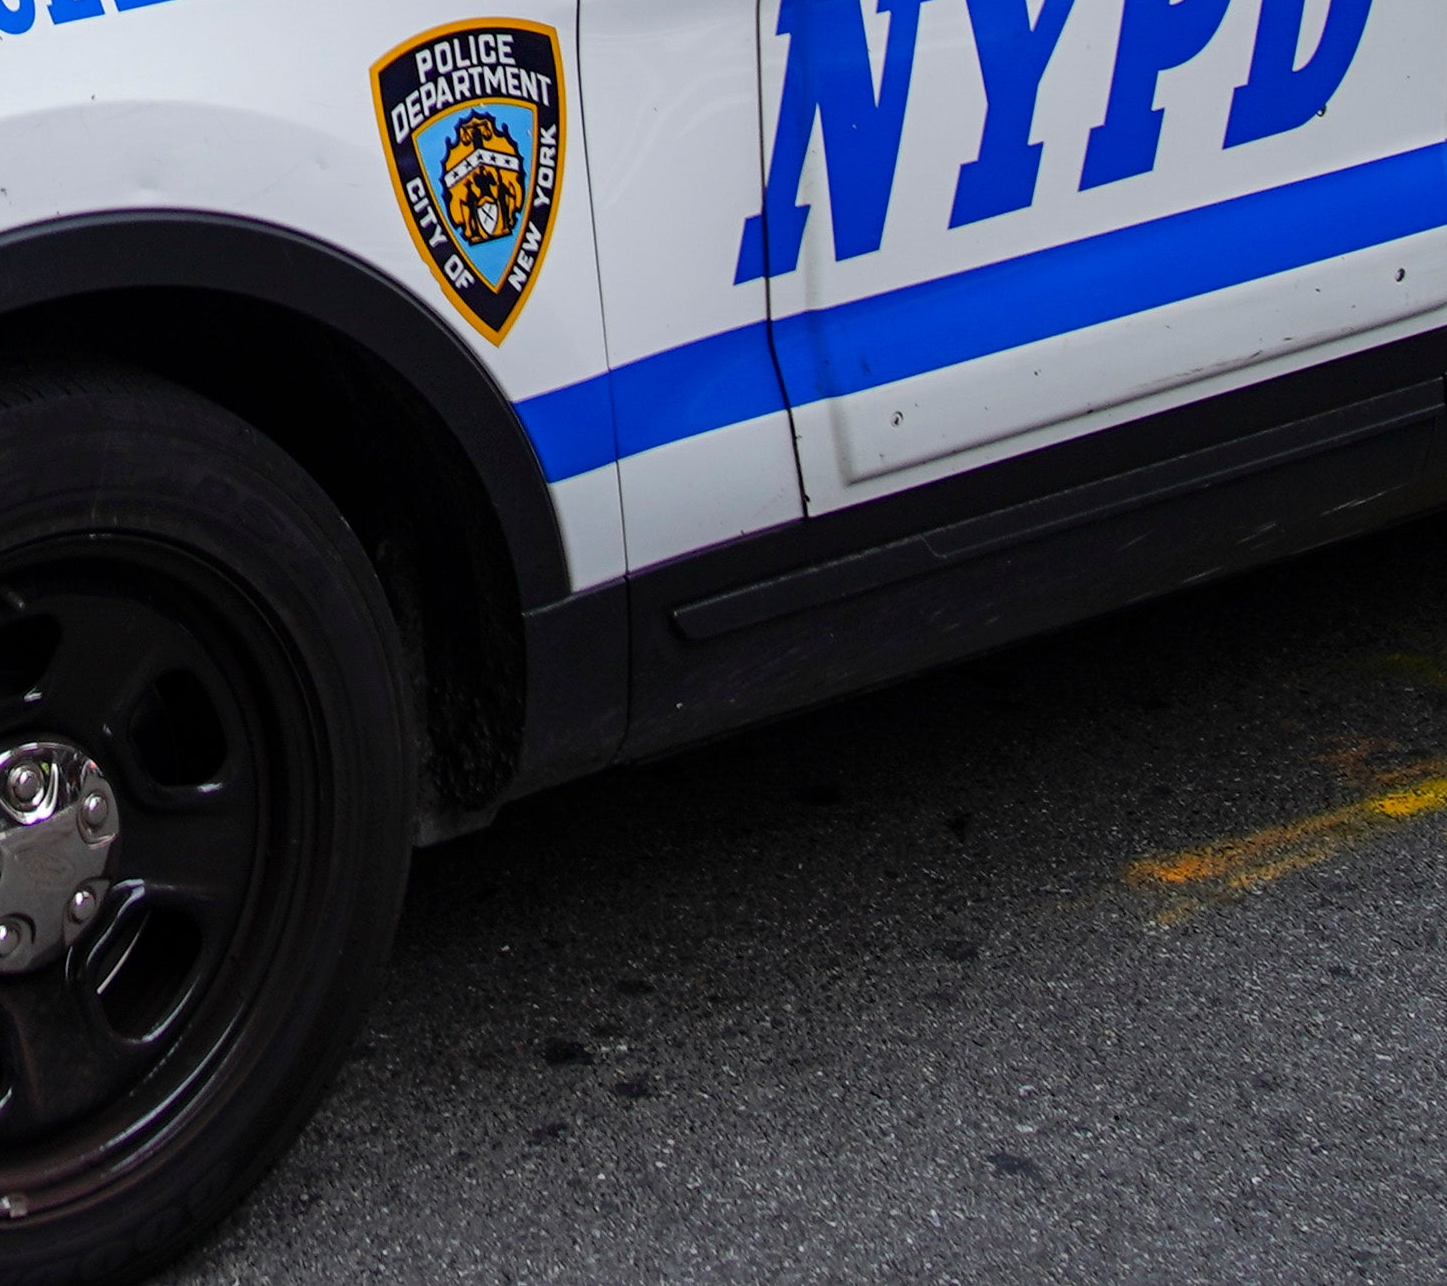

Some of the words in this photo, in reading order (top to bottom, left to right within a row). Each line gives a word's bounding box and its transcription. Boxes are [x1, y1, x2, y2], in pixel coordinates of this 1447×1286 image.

[391, 64, 552, 144] DEPARTMENT
[415, 33, 516, 84] POLICE
[406, 177, 452, 248] CITY
[443, 253, 476, 290] OF
[507, 225, 543, 294] NEW
[534, 123, 559, 207] YORK
